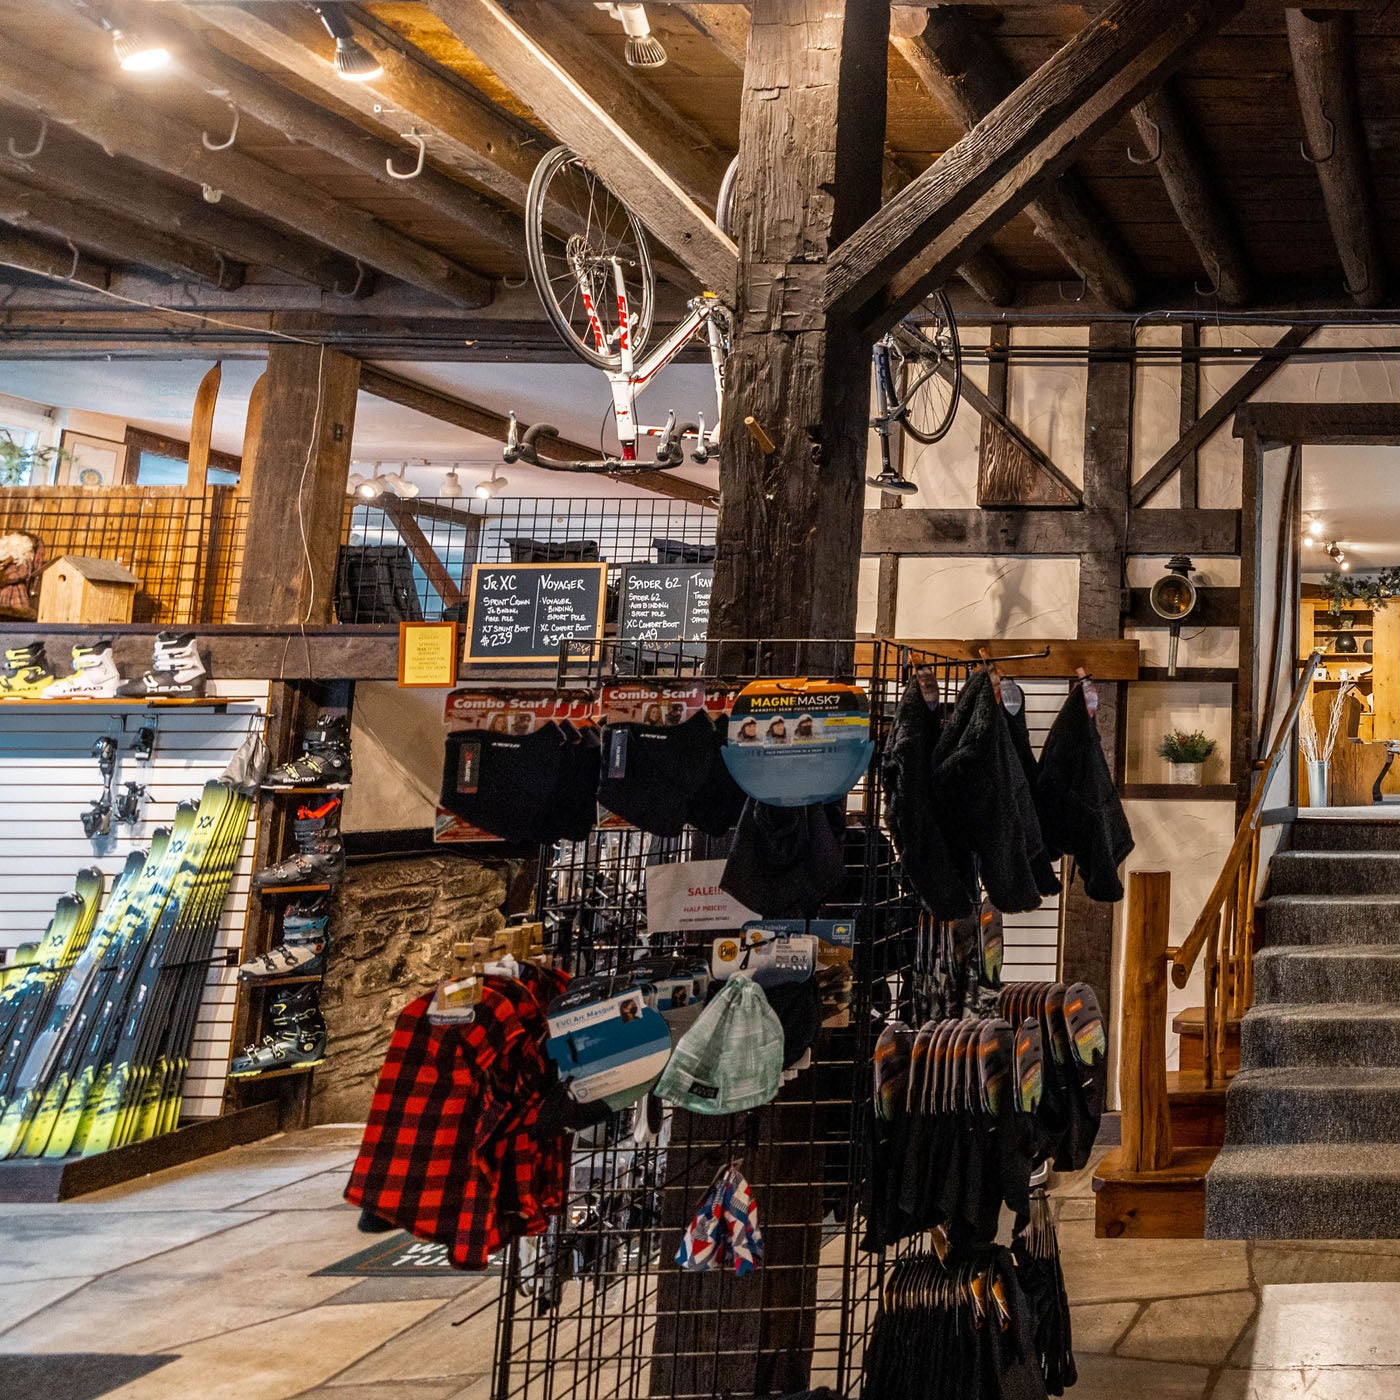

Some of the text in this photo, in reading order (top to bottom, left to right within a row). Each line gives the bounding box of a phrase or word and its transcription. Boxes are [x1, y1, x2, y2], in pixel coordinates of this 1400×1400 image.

[500, 575, 517, 590] XC
[541, 574, 585, 590] VOYAGER
[628, 576, 682, 590] SPIDER 62
[628, 593, 660, 601] SPIDER 62
[548, 605, 573, 613] BINDING
[547, 613, 569, 621] SPORT
[514, 624, 531, 633] BOOT
[540, 623, 592, 632] XC COMFORT BOOT
[627, 619, 680, 629] XC COMFORT BOOT
[480, 632, 513, 647] $239
[147, 685, 193, 693] HEAD
[609, 688, 698, 699] Combo Scarf
[453, 698, 549, 709] Combo Scarf
[586, 1004, 615, 1018] Masque
